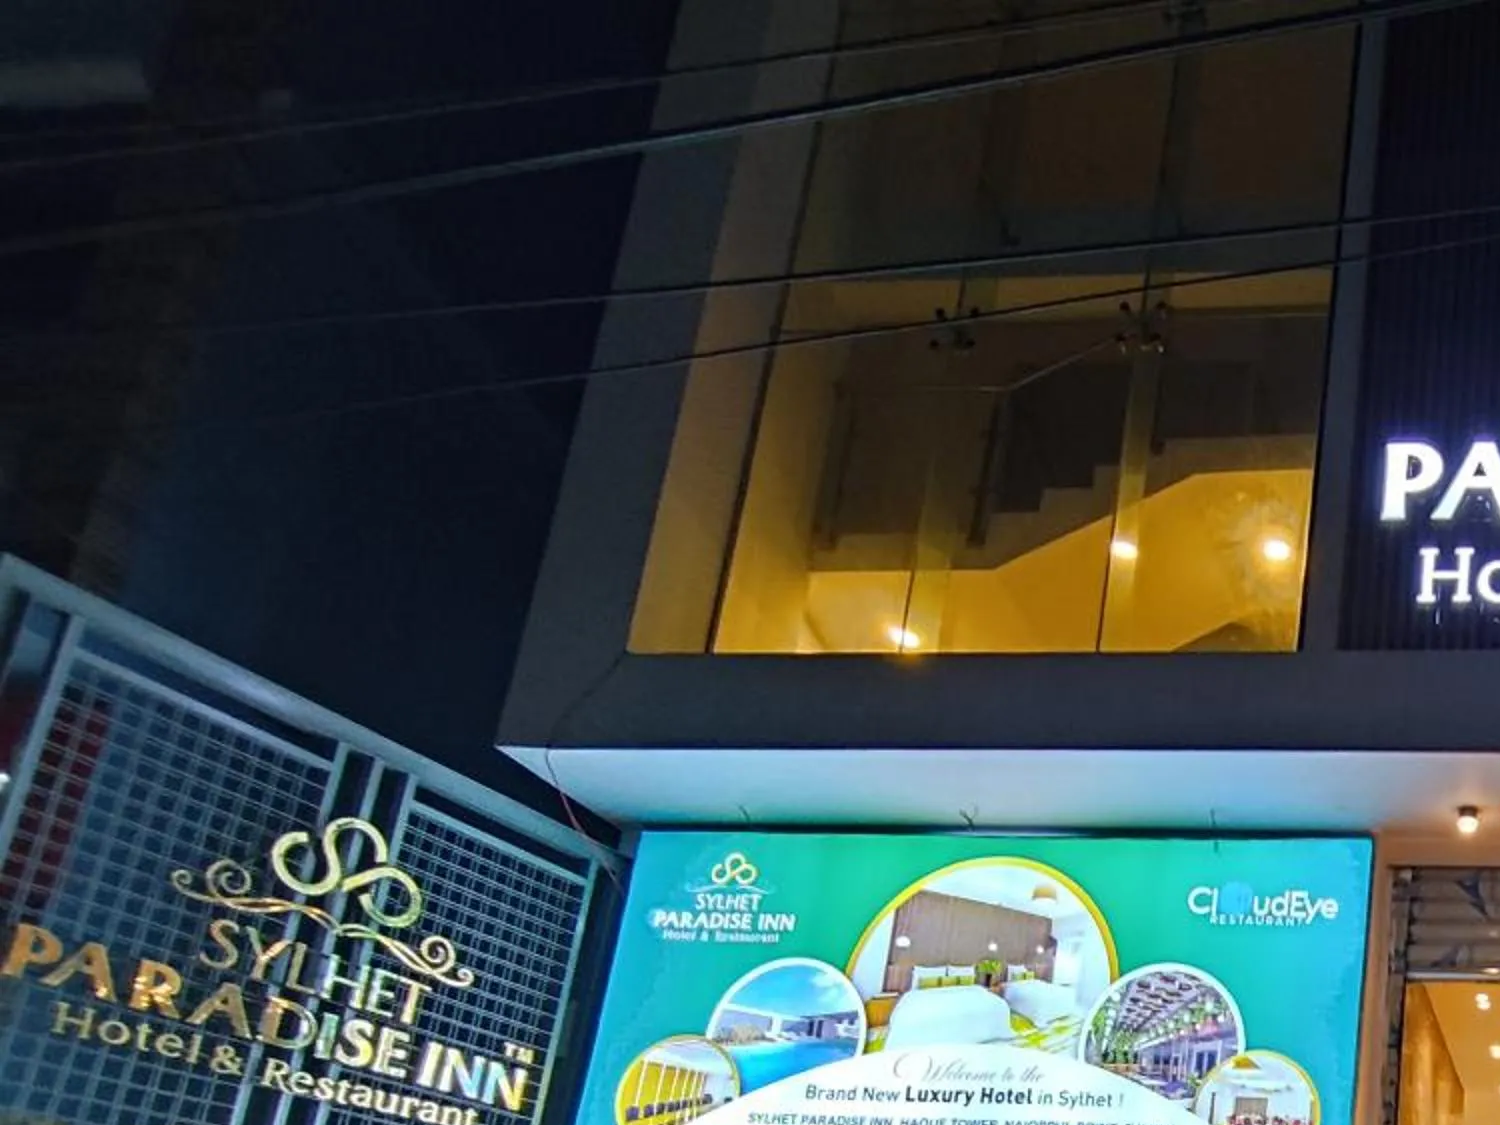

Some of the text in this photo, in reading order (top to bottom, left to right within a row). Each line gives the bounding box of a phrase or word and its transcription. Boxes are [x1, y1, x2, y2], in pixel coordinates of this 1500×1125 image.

[695, 893, 762, 911] SYLHET
[653, 910, 796, 932] PARADISE INN
[1209, 913, 1303, 927] RESTAURANT
[200, 919, 432, 1025] SYLHET
[1, 922, 412, 1080] PARADISE
[416, 1040, 528, 1112] INN
[51, 1001, 203, 1065] Hotel
[210, 1045, 245, 1077] &
[893, 1053, 1045, 1083] Welcome to the
[805, 1084, 857, 1101] Brand
[862, 1087, 901, 1102] New
[905, 1085, 975, 1107] Luxury
[980, 1087, 1032, 1105] Hotel
[1037, 1091, 1053, 1106] in
[1058, 1091, 1113, 1110] Sylhet
[747, 1112, 798, 1125] SYLHET
